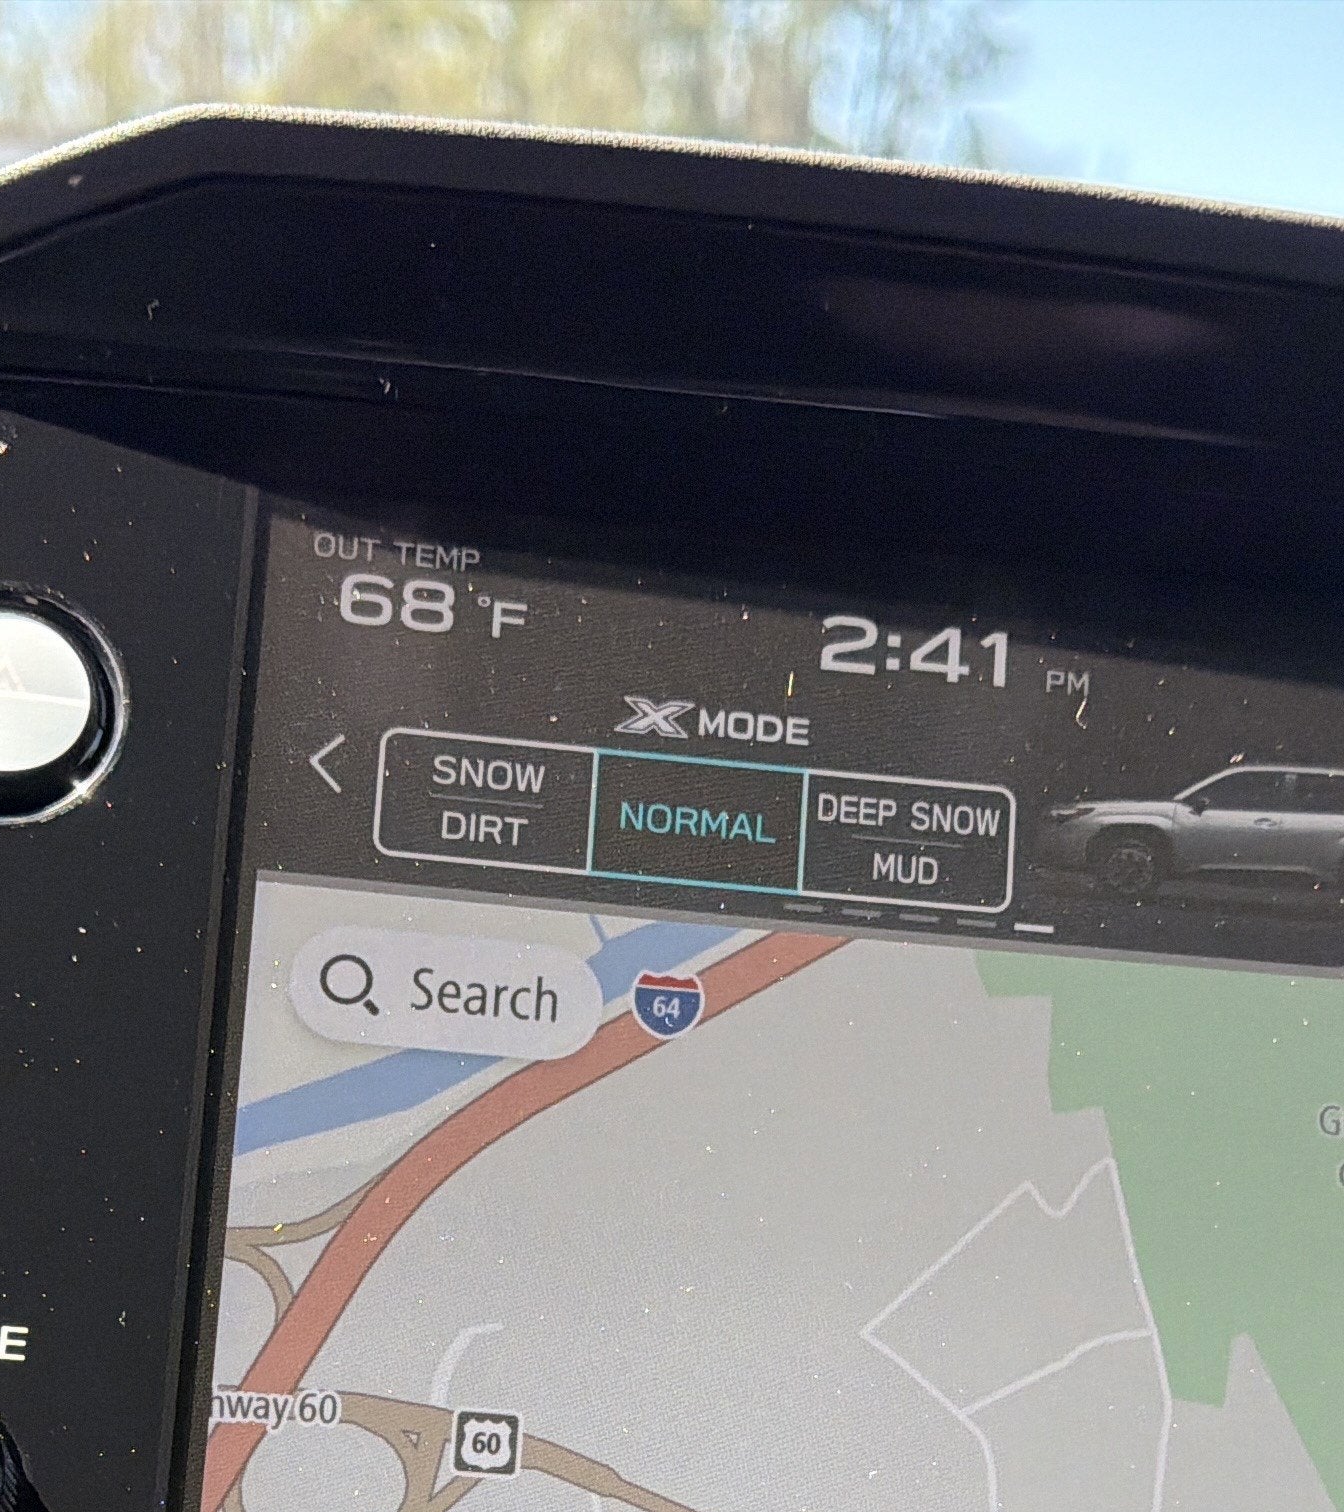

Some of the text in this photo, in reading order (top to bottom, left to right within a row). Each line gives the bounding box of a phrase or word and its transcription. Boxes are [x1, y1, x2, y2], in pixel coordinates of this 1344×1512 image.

[313, 531, 481, 572] OUT TEMP
[340, 573, 455, 632] 68
[819, 615, 1090, 697] 2:41 PM
[697, 706, 810, 746] MODE
[432, 754, 546, 795] SNOW
[440, 811, 530, 848] DIRT
[619, 801, 777, 844] NORMAL
[817, 793, 1000, 838] DEEP SNOW
[872, 852, 940, 887] MUD
[411, 966, 559, 1023] Search
[652, 995, 682, 1019] 64
[298, 1392, 338, 1425] 60
[472, 1431, 502, 1455] 60
